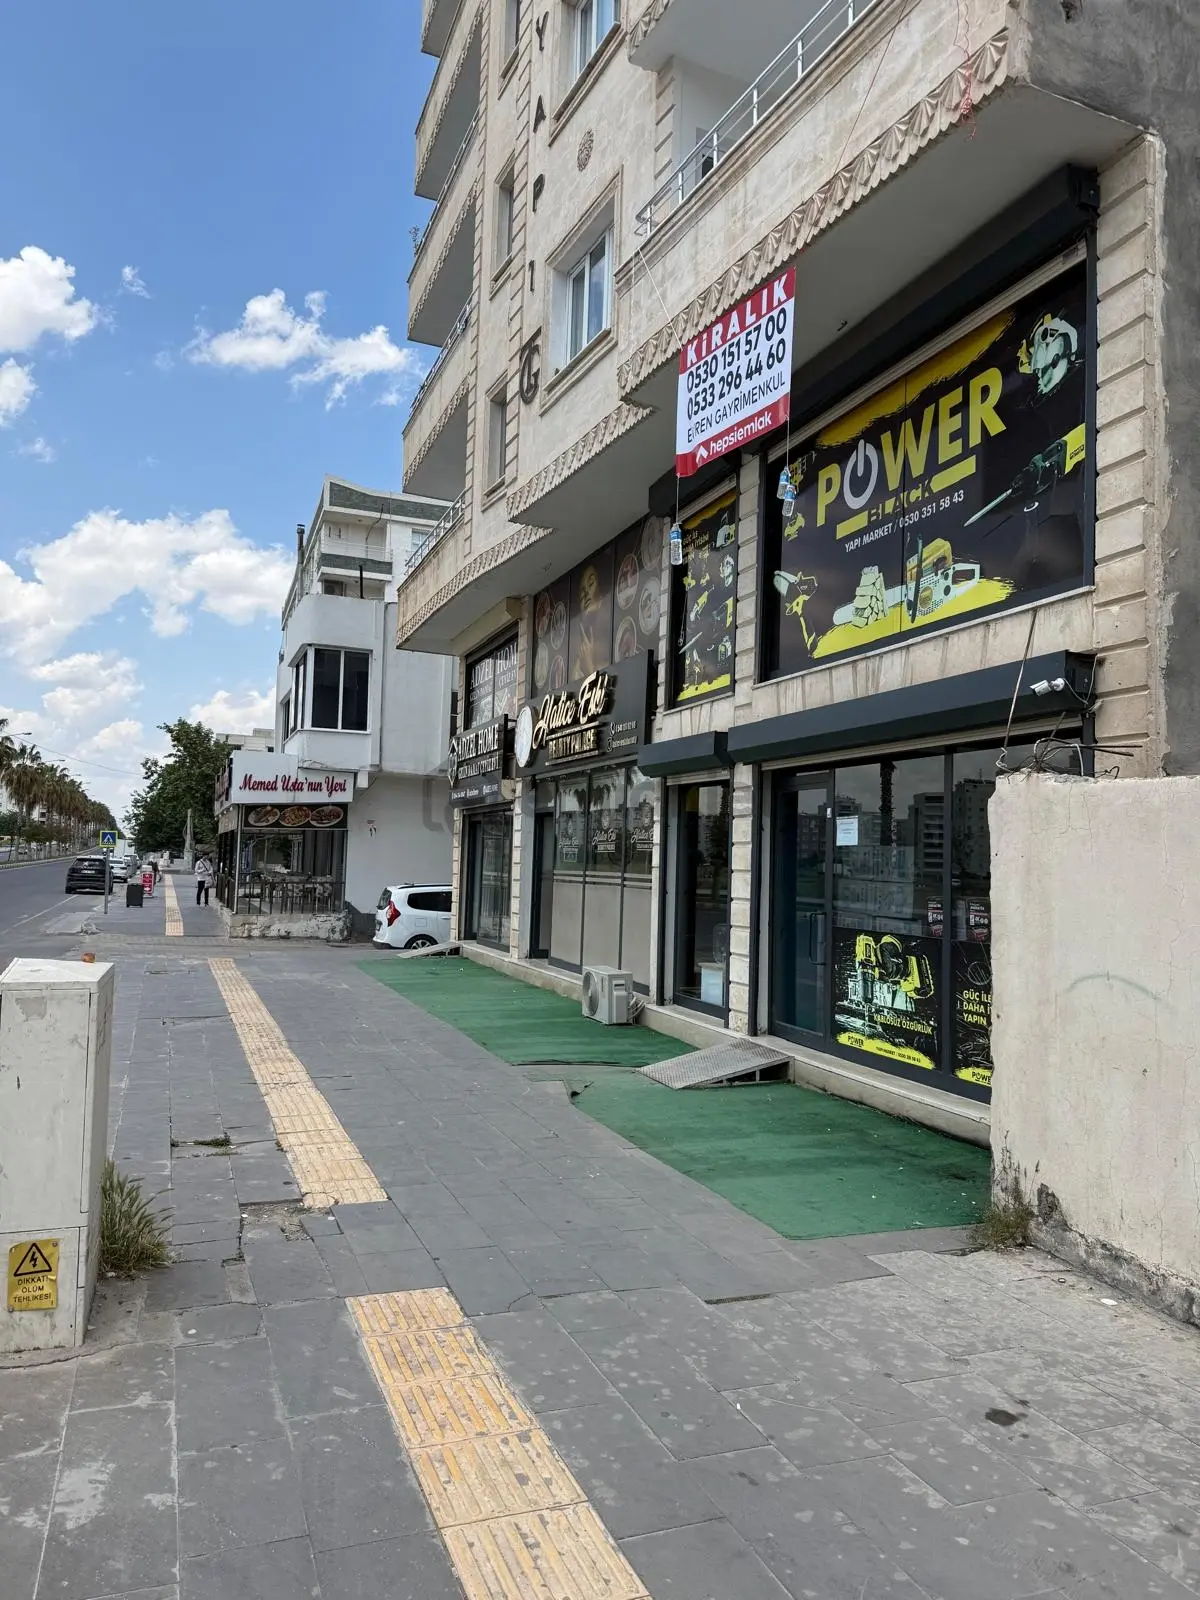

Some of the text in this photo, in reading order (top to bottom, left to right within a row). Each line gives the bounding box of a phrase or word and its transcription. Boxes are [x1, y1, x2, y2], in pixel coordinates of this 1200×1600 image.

[686, 274, 788, 369] KİRALIK
[687, 307, 787, 393] 0530 151 57 00
[687, 338, 786, 420] 0533 296 44 60
[715, 371, 785, 424] GAYRİMENKUL
[709, 411, 772, 455] hepsiemlak
[816, 367, 1006, 527] POWER
[845, 536, 861, 552] YAPI
[862, 523, 893, 550] MARKET
[899, 510, 920, 528] 0530
[921, 502, 936, 518] 351
[939, 496, 951, 511] 58
[952, 489, 964, 504] 43
[478, 723, 499, 755] HOME
[239, 773, 278, 792] Memed
[325, 776, 347, 798] Yeri
[963, 1001, 985, 1014] DAHA
[963, 1012, 987, 1026] YAPIN
